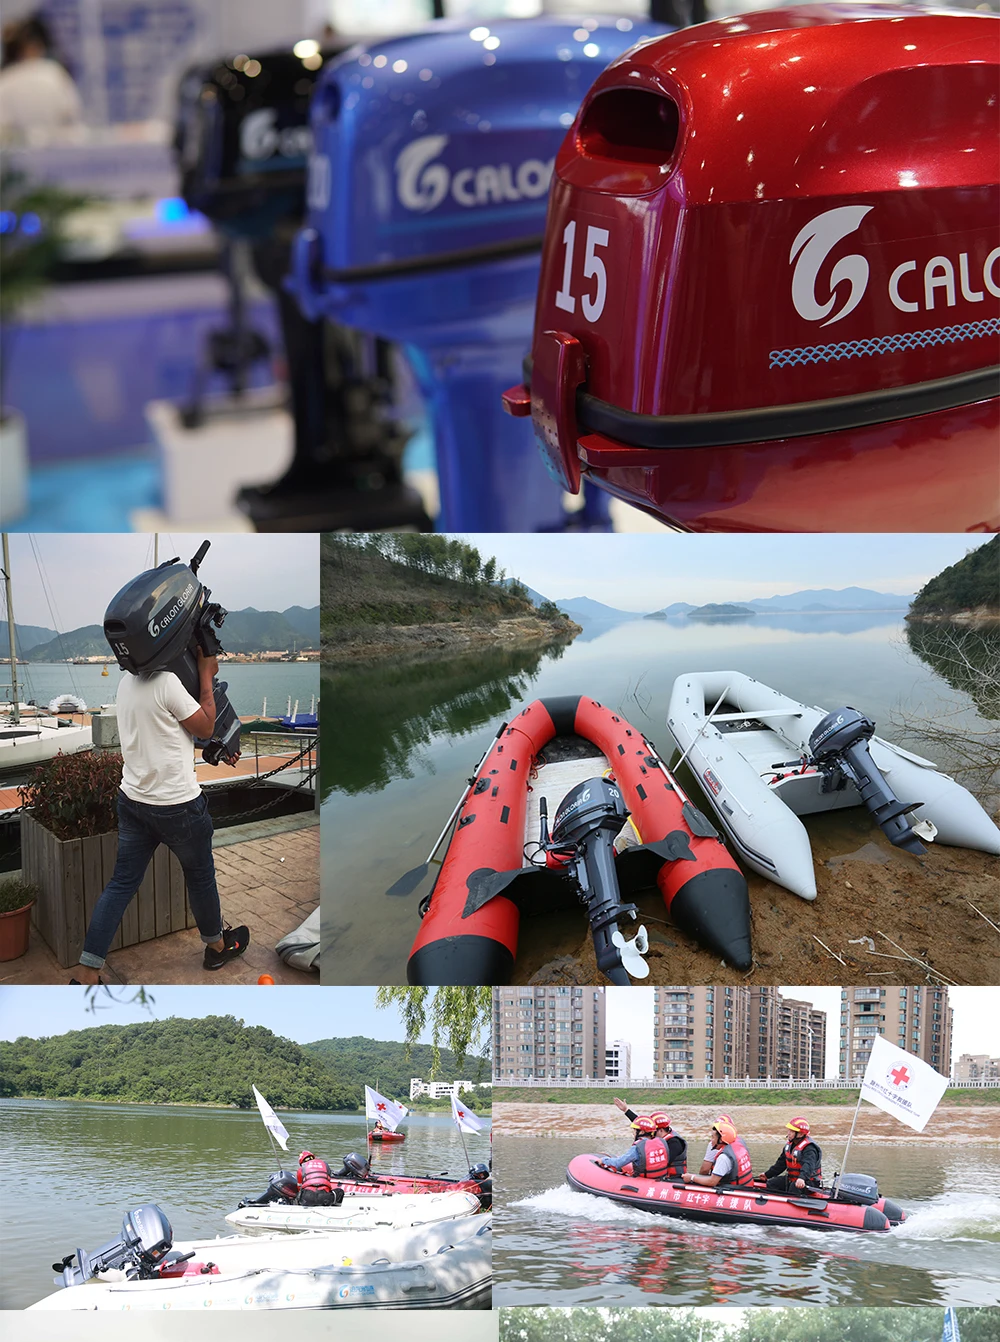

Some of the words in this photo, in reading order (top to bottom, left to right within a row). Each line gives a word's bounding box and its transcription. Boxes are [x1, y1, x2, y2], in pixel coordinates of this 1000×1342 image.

[452, 156, 557, 207] CALO
[555, 220, 609, 323] 15
[160, 605, 179, 629] CALON
[177, 583, 195, 608] GLORIA
[114, 642, 130, 656] 15
[608, 787, 620, 799] 20
